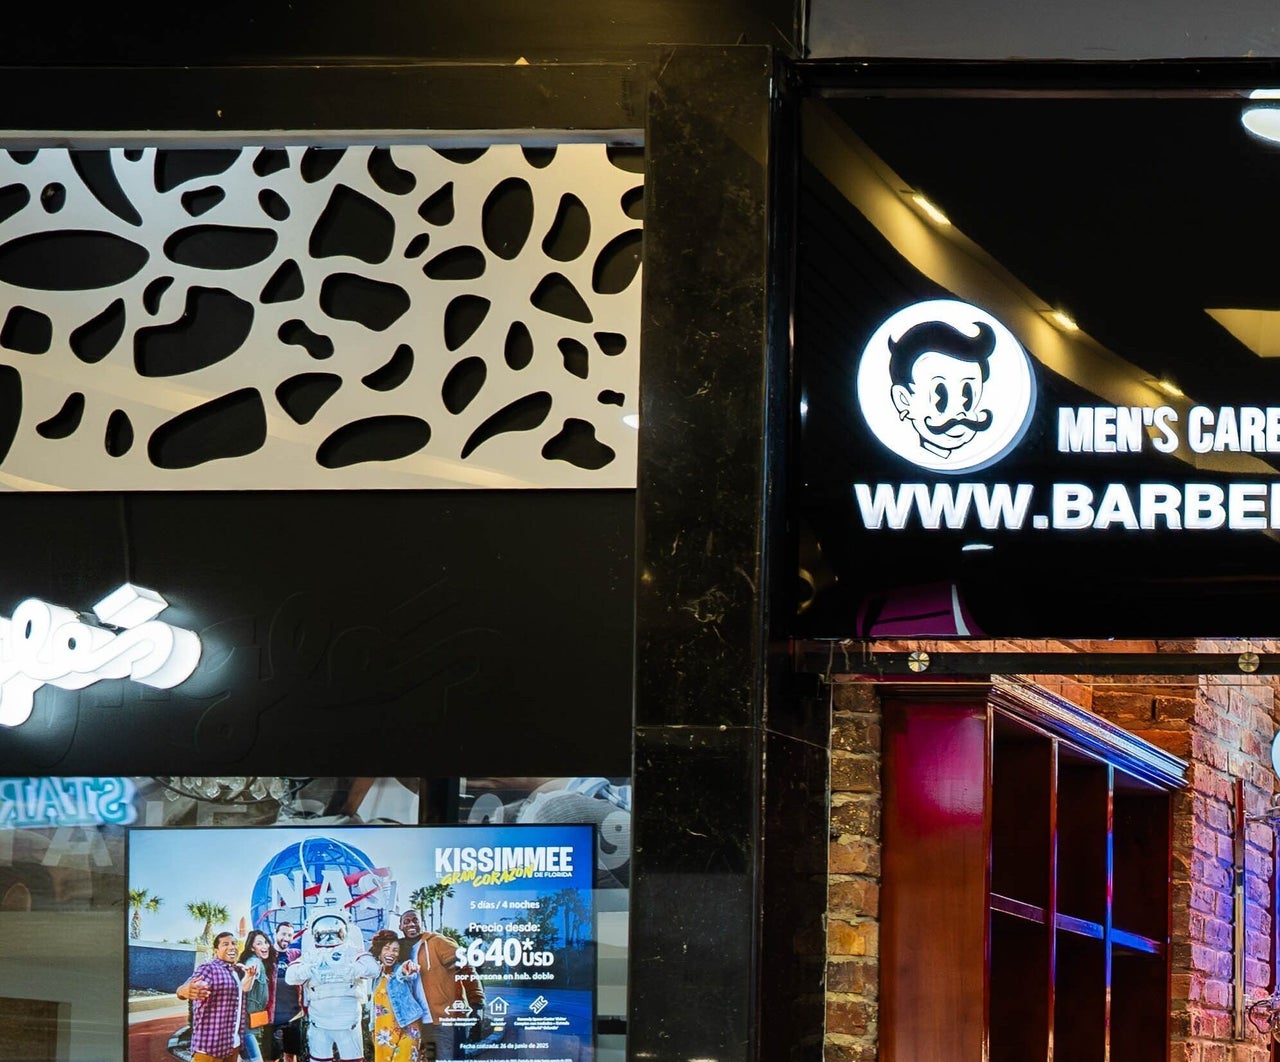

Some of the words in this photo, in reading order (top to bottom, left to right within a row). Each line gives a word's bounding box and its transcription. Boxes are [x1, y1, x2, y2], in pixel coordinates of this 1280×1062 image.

[1058, 406, 1179, 453] MEN'S
[434, 846, 574, 873] KISSIMMEE
[441, 868, 477, 886] GRAN
[470, 901, 477, 909] 5
[478, 900, 495, 909] días
[502, 901, 508, 909] 4
[509, 900, 540, 909] noches
[469, 922, 503, 933] Precio
[505, 922, 541, 933] desde:
[522, 952, 554, 966] USD
[454, 974, 469, 982] por
[515, 972, 531, 980] hab.
[533, 972, 554, 980] doble
